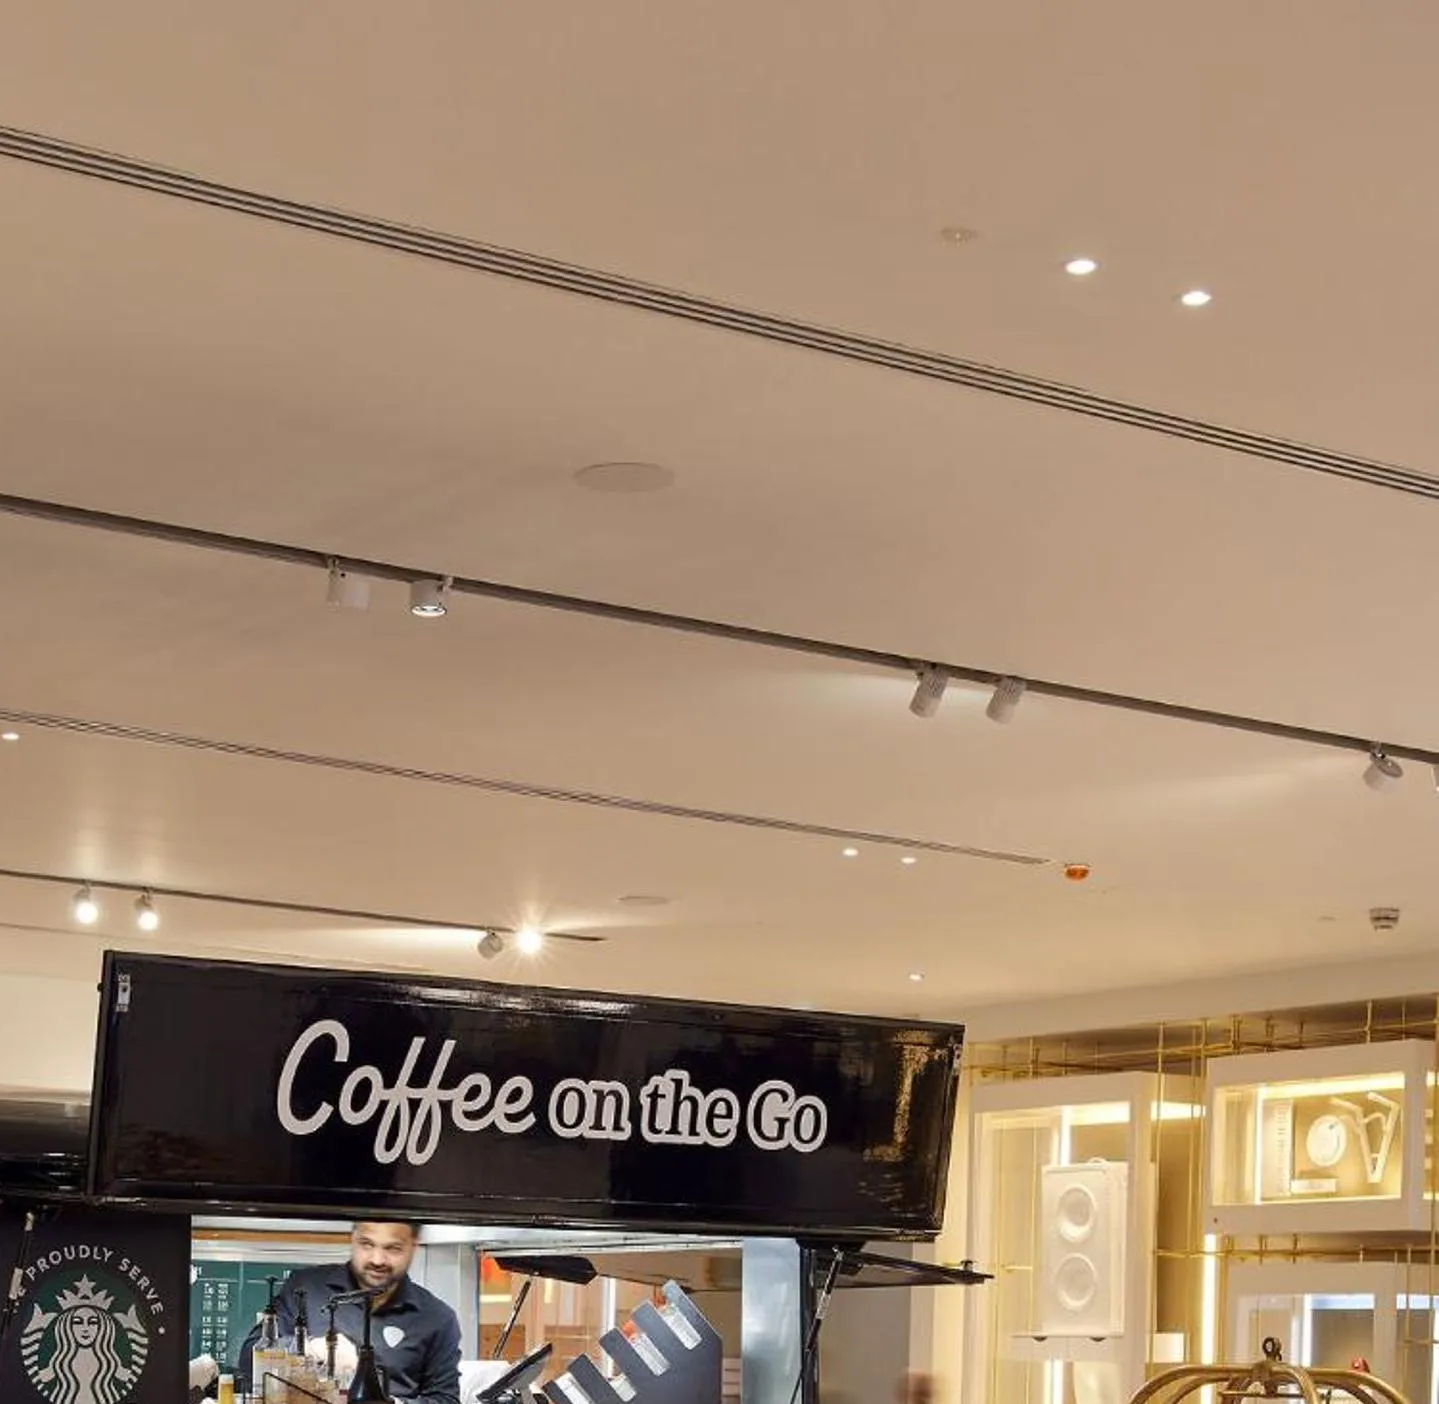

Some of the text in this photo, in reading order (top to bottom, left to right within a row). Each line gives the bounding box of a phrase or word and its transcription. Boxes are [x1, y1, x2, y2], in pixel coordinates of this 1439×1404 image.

[277, 1019, 828, 1166] Coffee on the Go
[25, 1244, 164, 1315] PROUDLY SERVE
